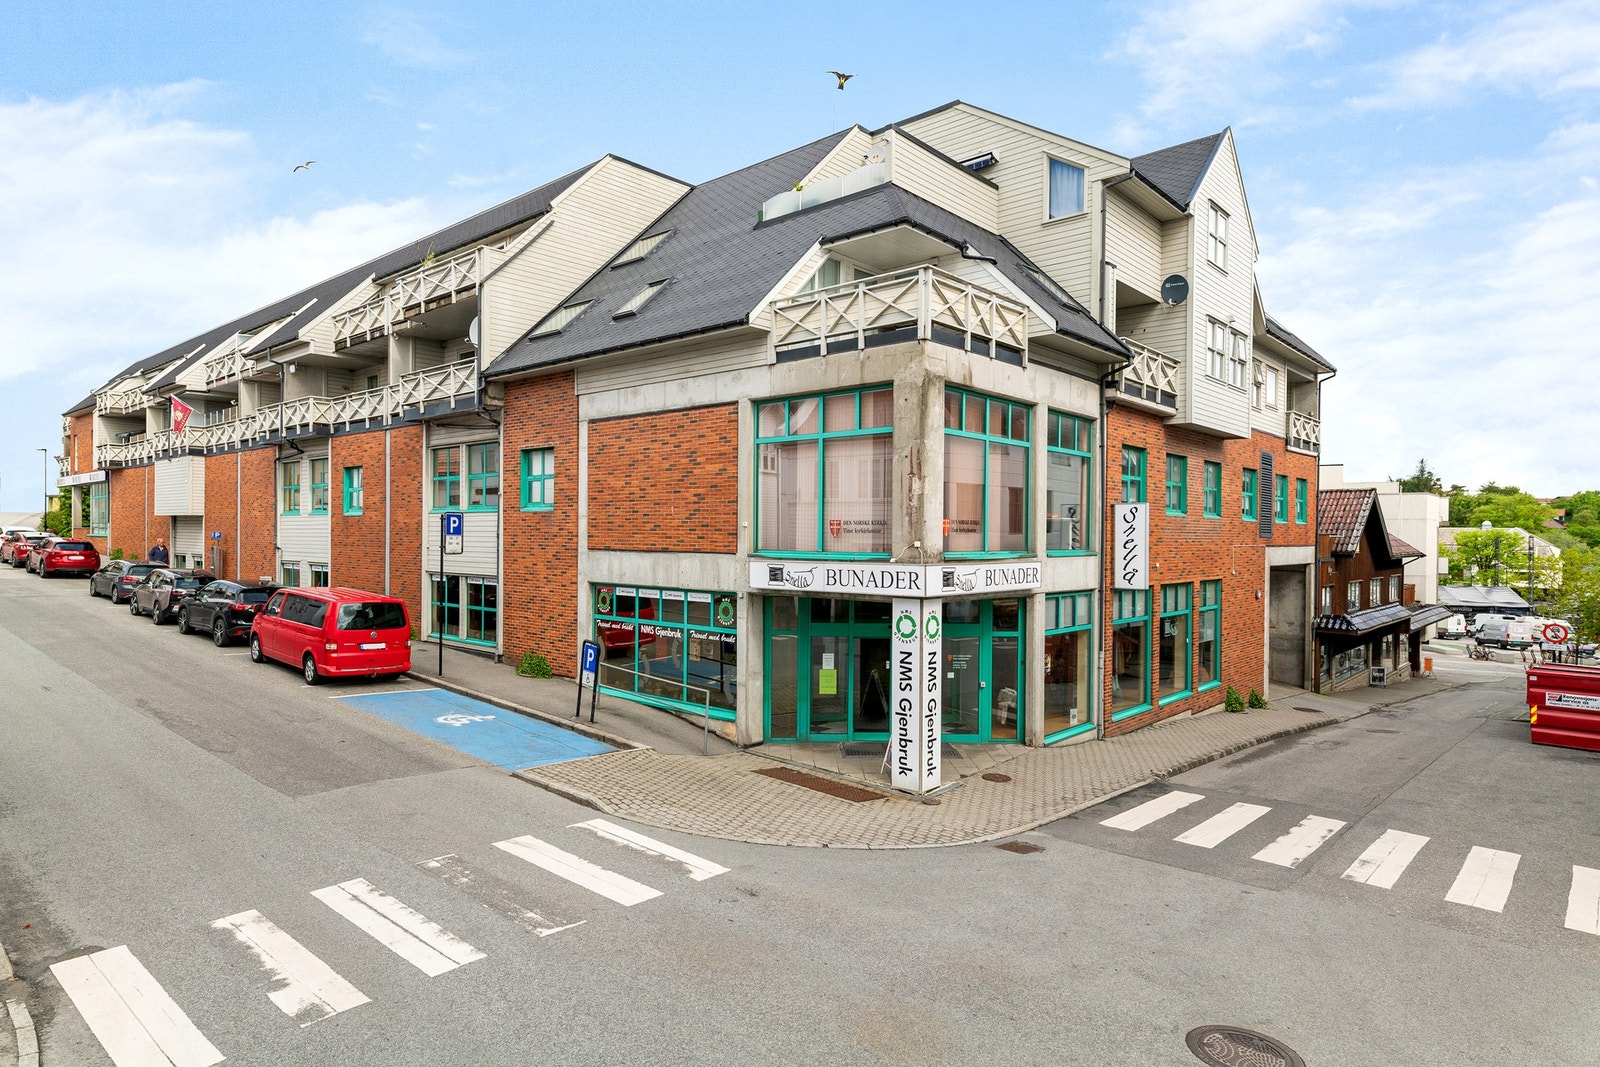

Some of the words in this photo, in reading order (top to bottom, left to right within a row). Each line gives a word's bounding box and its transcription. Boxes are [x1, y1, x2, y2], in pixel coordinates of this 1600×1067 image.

[450, 517, 459, 533] P
[1123, 506, 1139, 585] Snellå
[826, 568, 922, 590] BUNADER
[985, 567, 1039, 588] BUNADER
[640, 624, 655, 635] NMS
[655, 627, 682, 639] Gjenbruk
[586, 649, 595, 669] P
[899, 651, 912, 692] NMS
[927, 651, 937, 693] NMS
[895, 698, 913, 777] Gjenbruk
[925, 698, 937, 778] Gjenbruk
